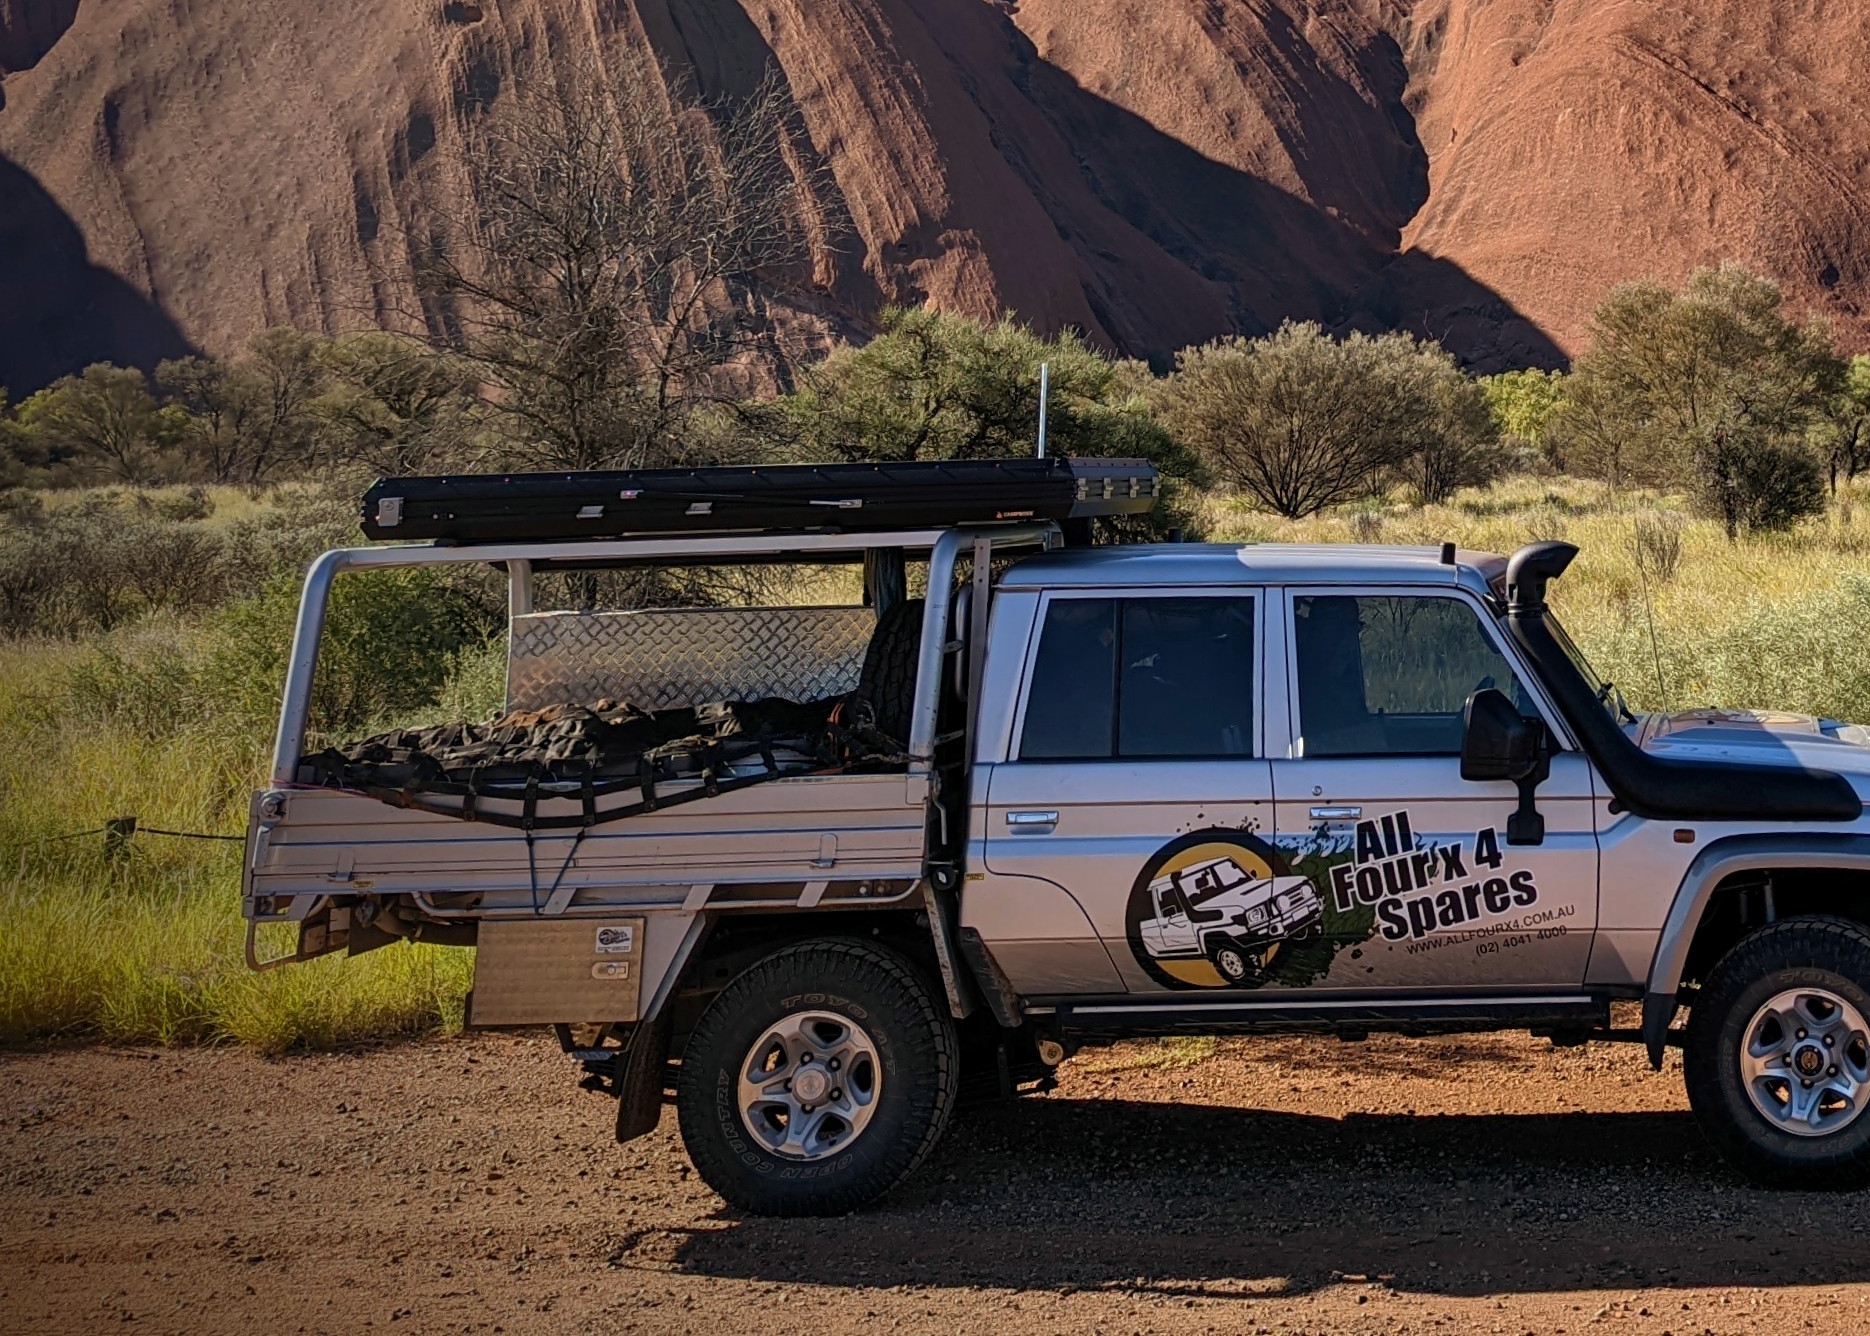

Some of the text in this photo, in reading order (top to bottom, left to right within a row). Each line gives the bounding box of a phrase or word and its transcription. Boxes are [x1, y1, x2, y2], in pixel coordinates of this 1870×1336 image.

[1356, 809, 1414, 865] All
[1331, 827, 1503, 911] Four x 4
[1377, 870, 1538, 939] Spares
[1407, 904, 1576, 954] WWW.ALLFOURX4.COM.AU
[1476, 924, 1567, 957] (02) 4041 4000
[781, 993, 869, 1020] TOYO
[717, 1068, 853, 1179] OPEN COUNTRY
